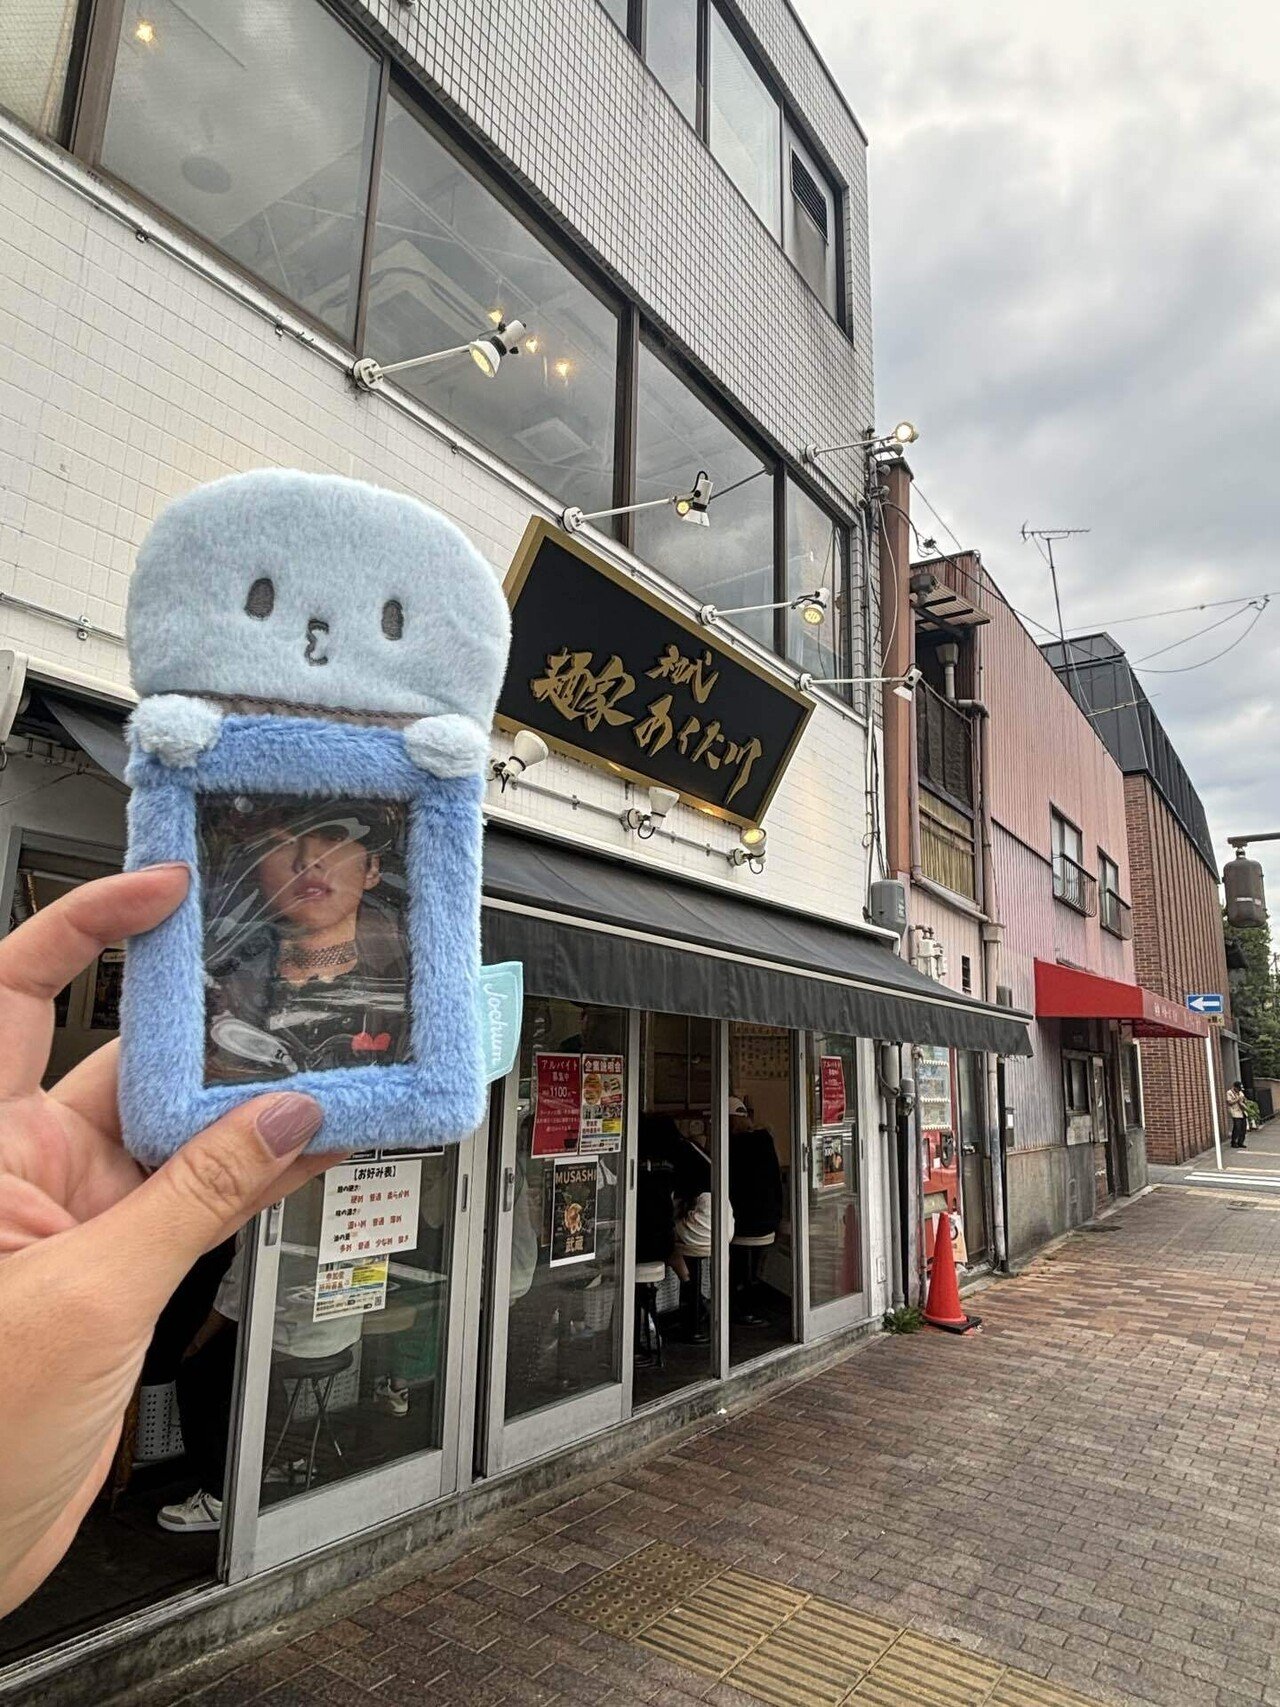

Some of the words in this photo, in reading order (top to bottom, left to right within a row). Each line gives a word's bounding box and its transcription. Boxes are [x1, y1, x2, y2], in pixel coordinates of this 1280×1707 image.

[541, 1059, 578, 1071] アルバイト
[555, 1168, 597, 1185] MUSASHI
